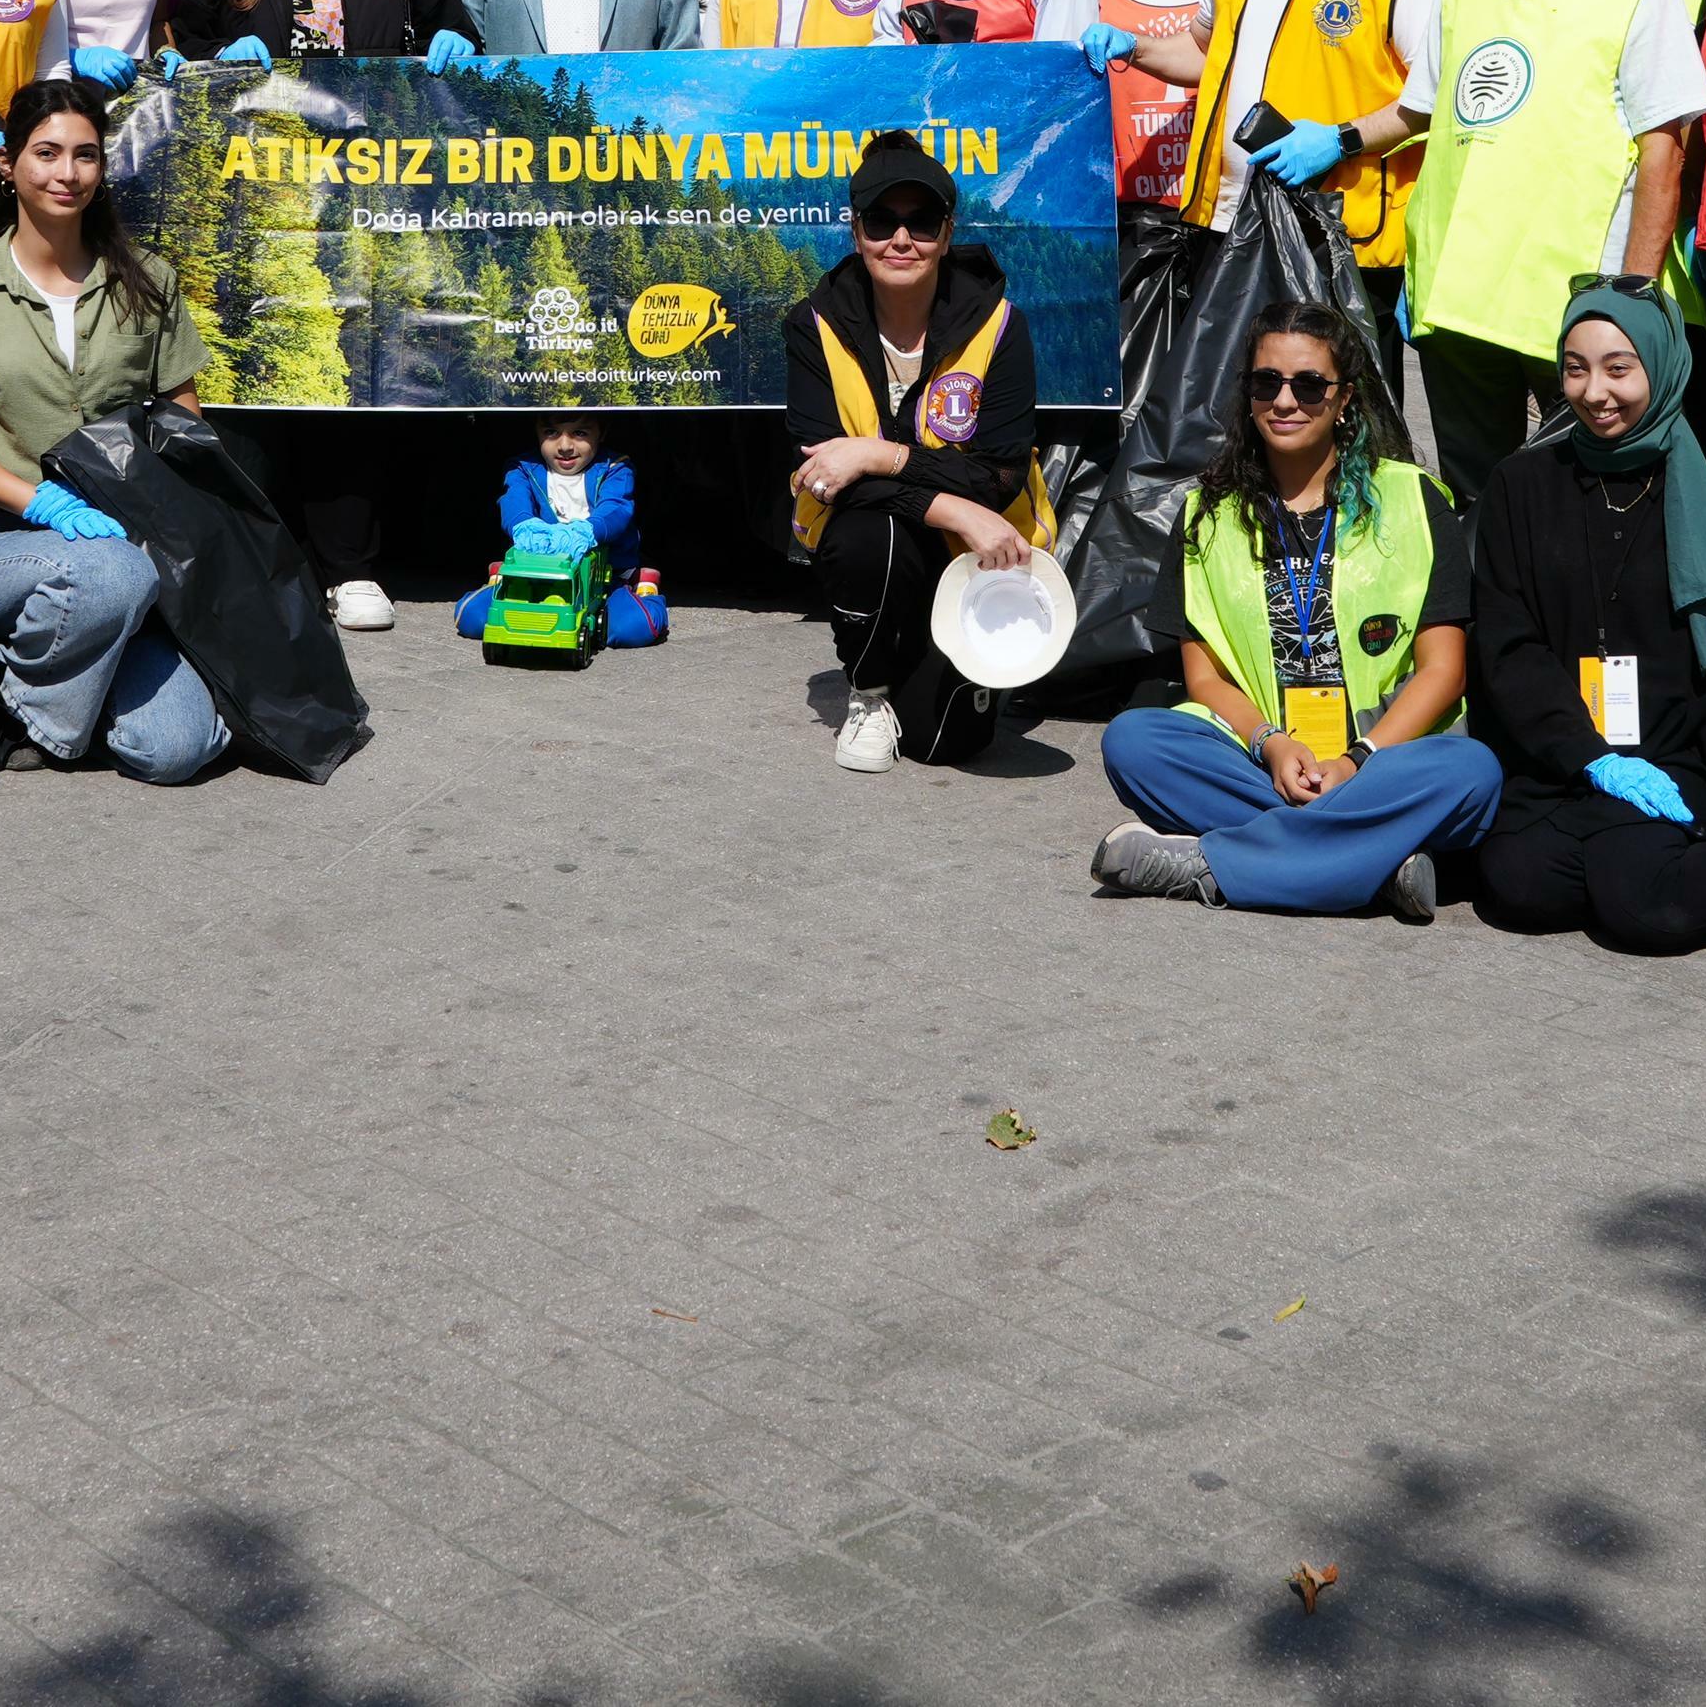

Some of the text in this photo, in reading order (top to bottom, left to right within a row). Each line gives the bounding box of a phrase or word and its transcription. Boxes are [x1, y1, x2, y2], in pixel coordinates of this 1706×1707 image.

[1330, 3, 1344, 23] L
[220, 118, 998, 186] ATIKSIZ BİR DÜNYA MÜMÜN
[353, 207, 422, 231] Doğa
[430, 207, 573, 229] Kahramanı
[581, 205, 660, 225] olarak
[666, 209, 712, 225] sen
[719, 205, 752, 225] de
[757, 203, 830, 228] yerini
[643, 294, 680, 309] DÜNYA
[494, 318, 618, 334] Let's do it!
[642, 310, 698, 327] TEMİZLİK
[525, 336, 594, 353] Türkiye
[640, 330, 670, 345] GÜNÜ
[501, 367, 721, 385] www.letsdoitturkey.com
[943, 379, 973, 393] LIONS
[949, 394, 967, 417] L
[1267, 581, 1286, 595] THE
